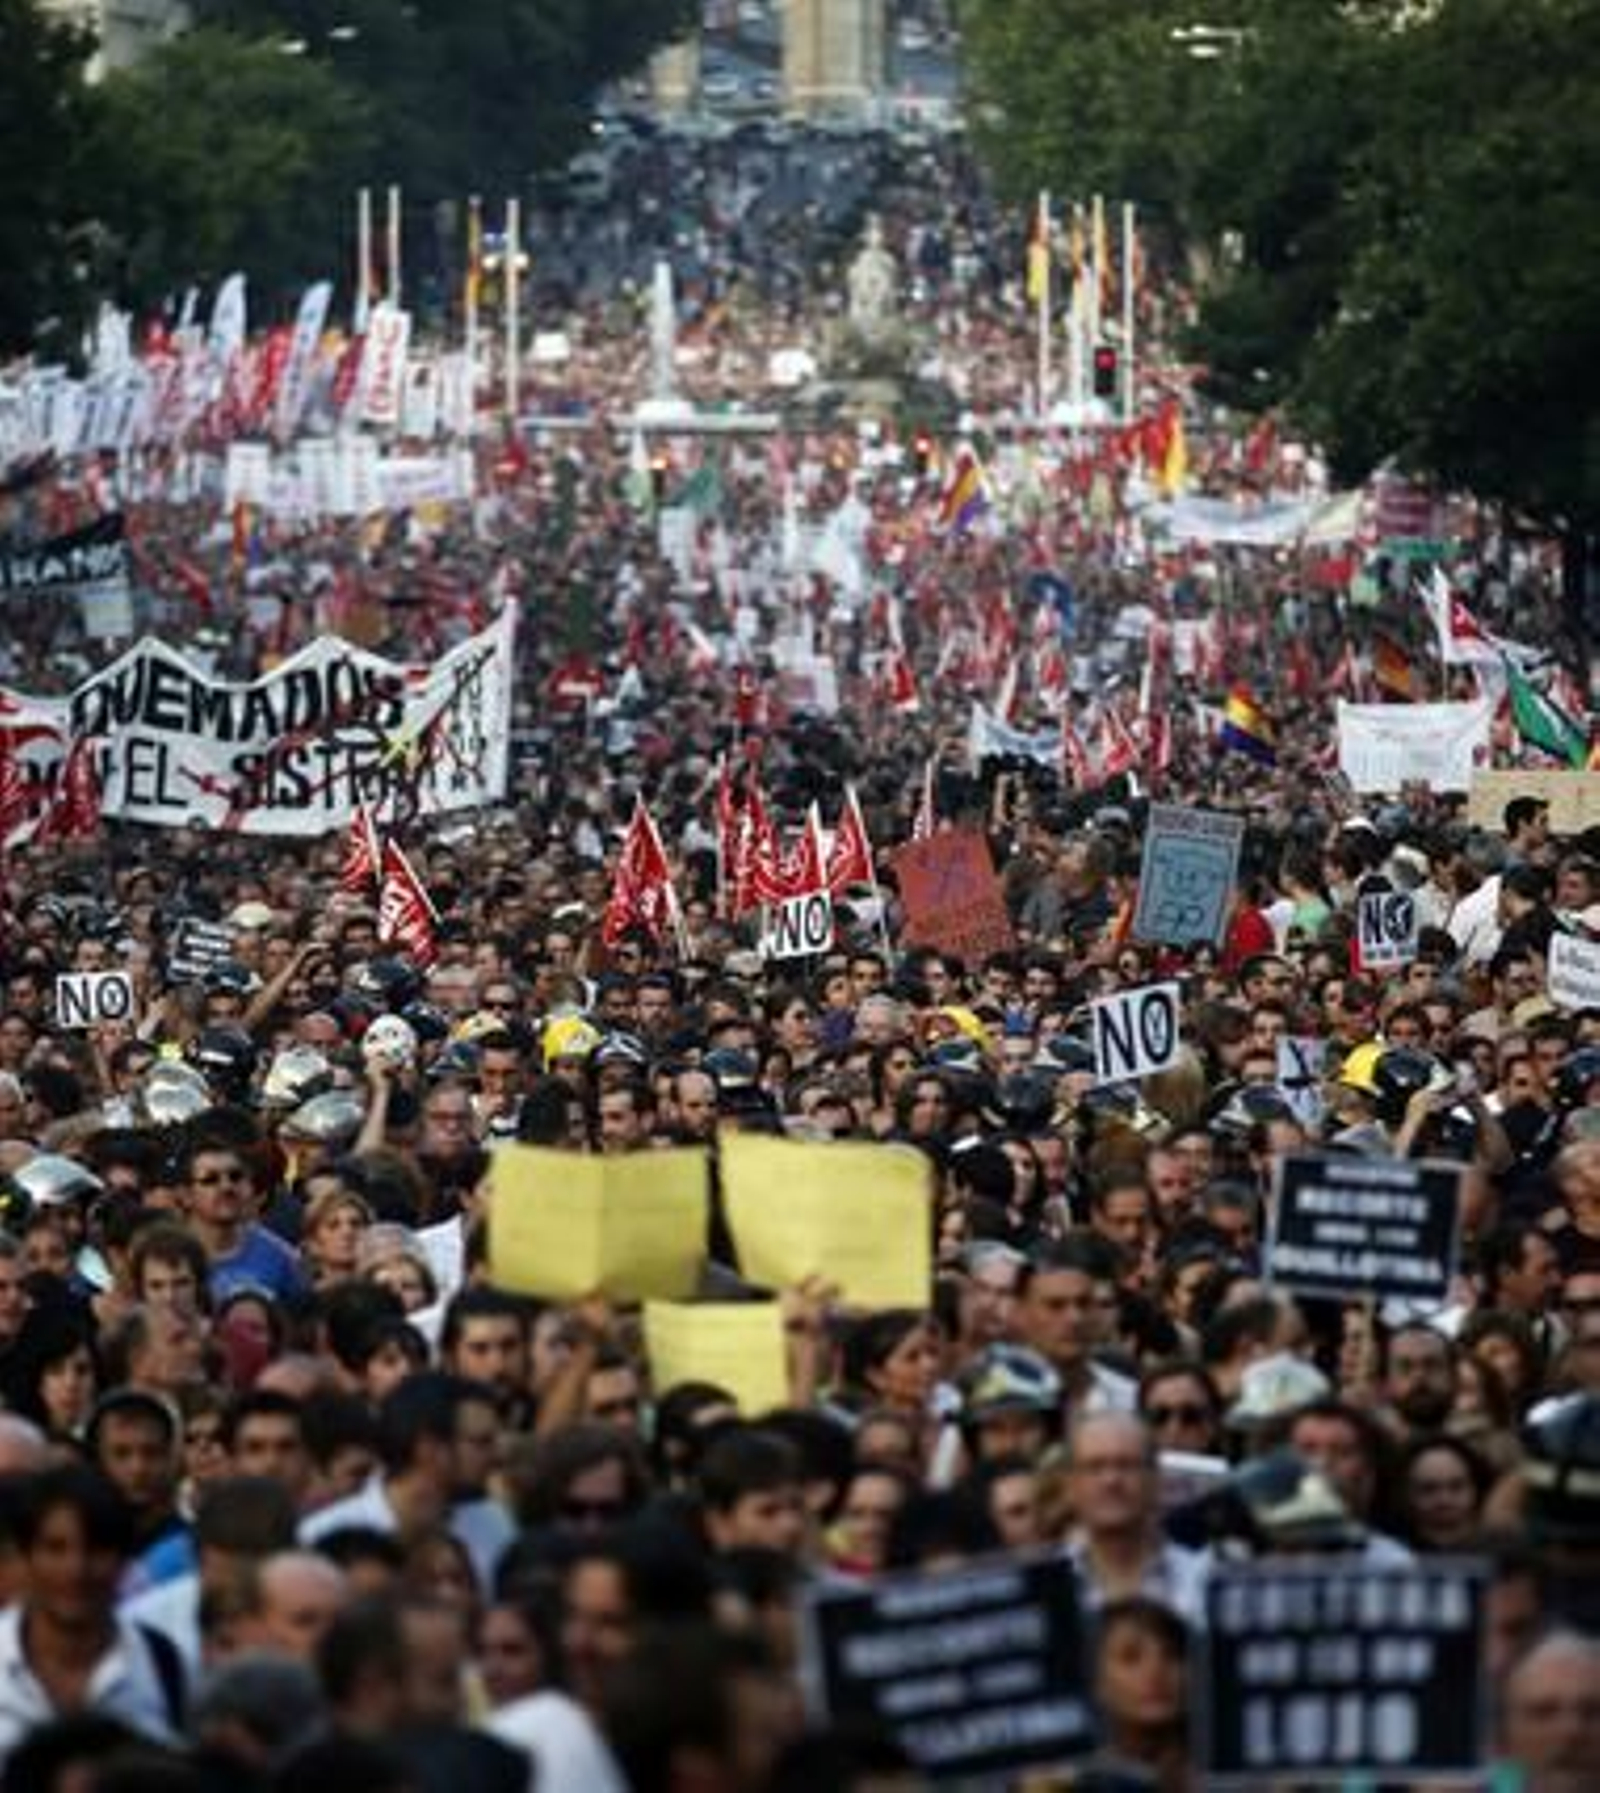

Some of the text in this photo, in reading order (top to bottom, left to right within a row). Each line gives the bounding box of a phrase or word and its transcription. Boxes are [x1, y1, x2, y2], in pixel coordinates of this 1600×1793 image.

[126, 738, 188, 806] EL
[777, 895, 830, 951] NO
[61, 976, 129, 1023] NO
[1099, 990, 1174, 1077] NO
